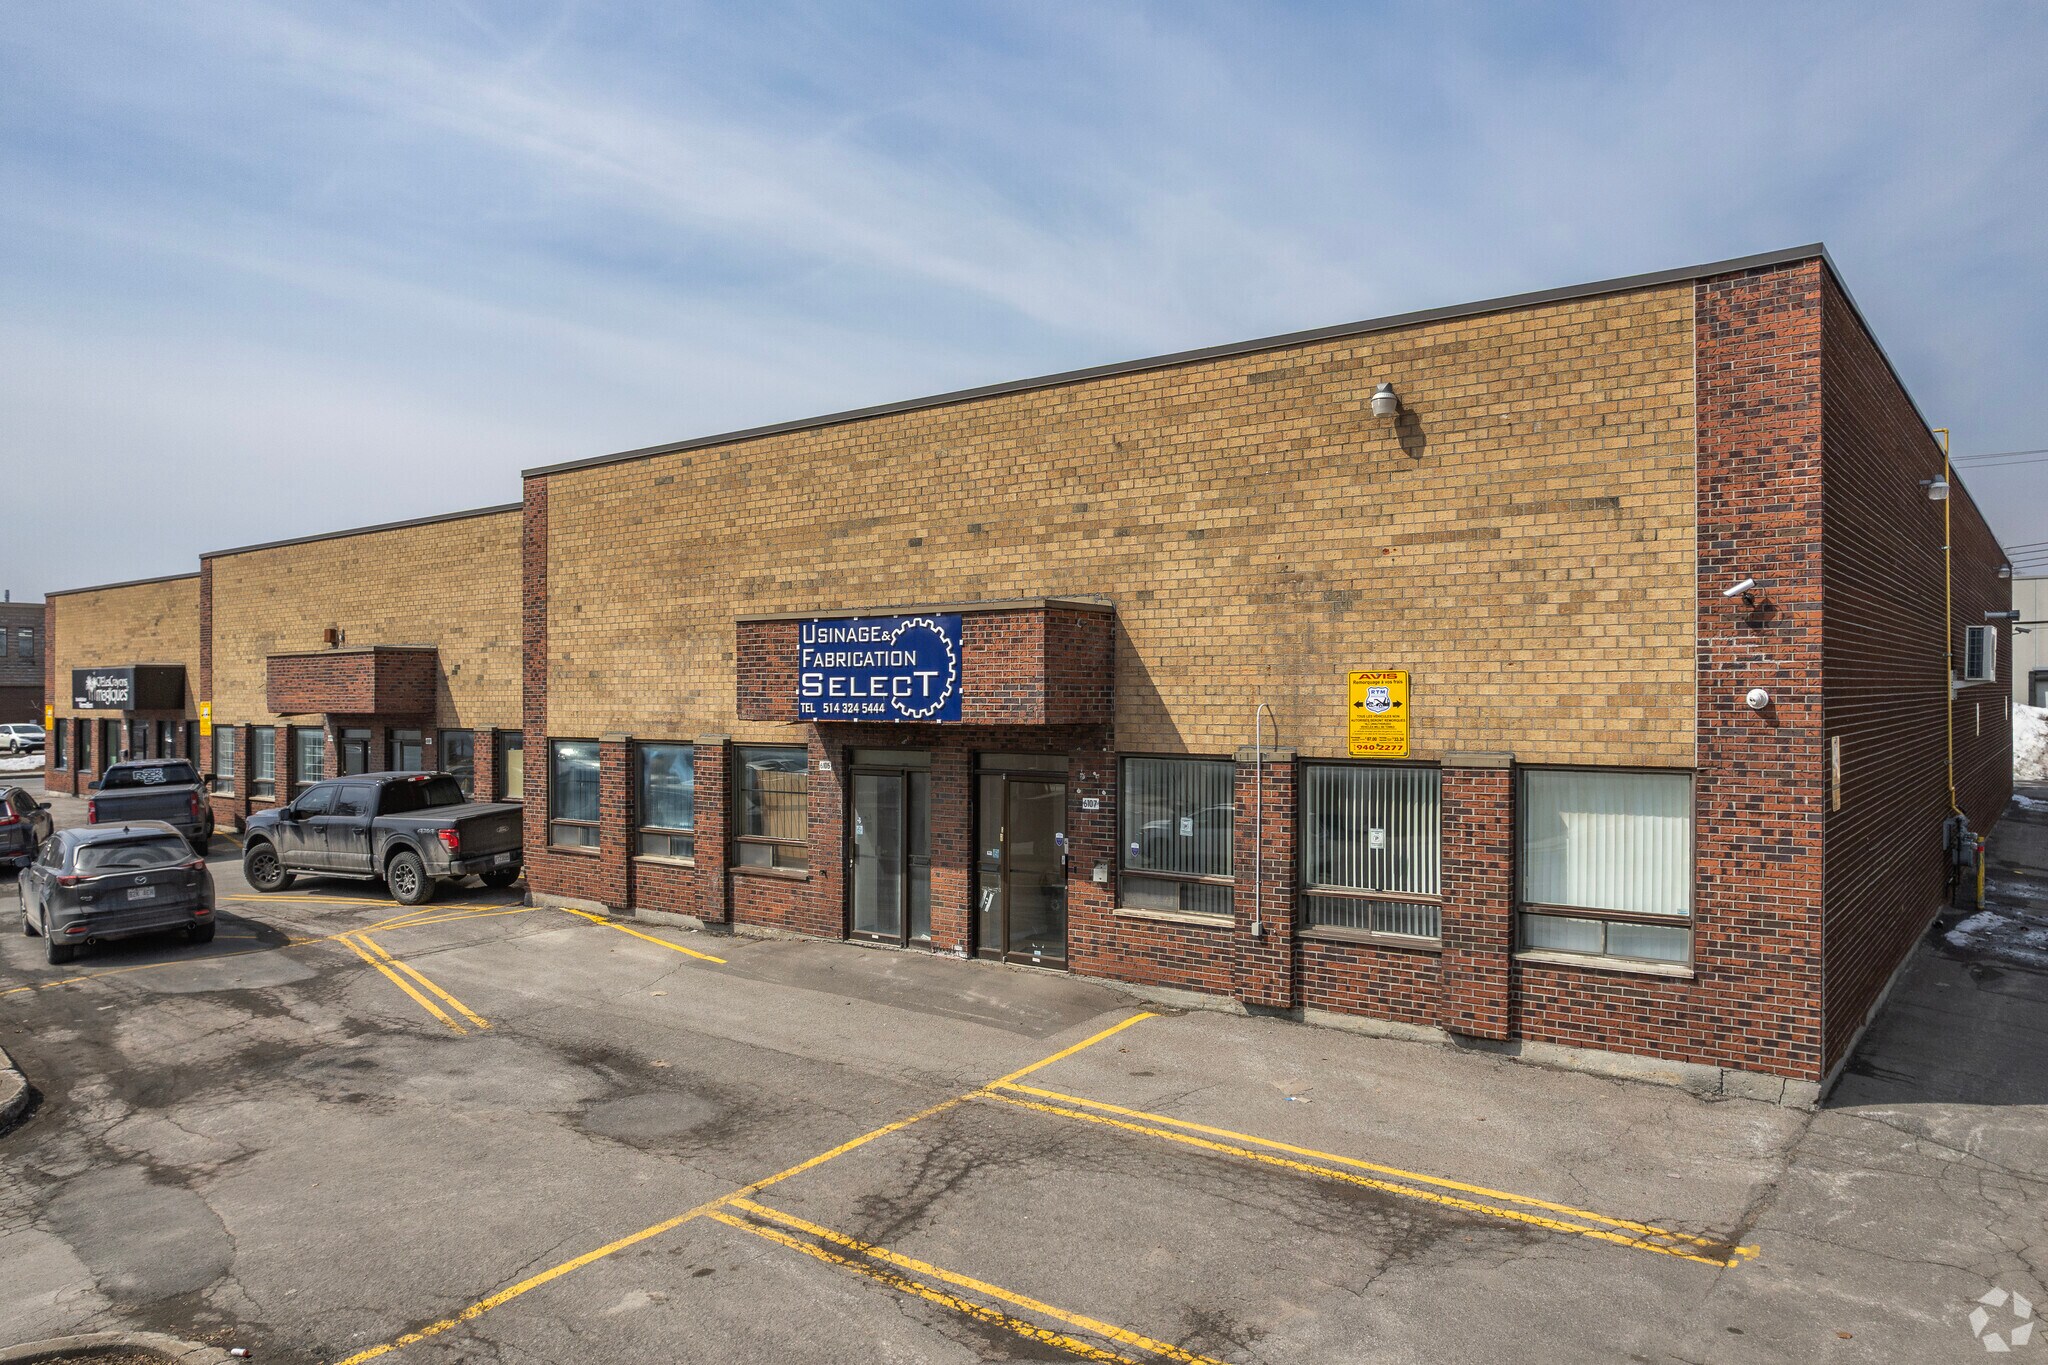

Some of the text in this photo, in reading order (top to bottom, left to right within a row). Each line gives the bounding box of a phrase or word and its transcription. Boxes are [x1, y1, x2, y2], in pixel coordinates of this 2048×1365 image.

[802, 624, 881, 644] USINAGE
[802, 648, 917, 668] FABRICATION
[801, 671, 939, 697] SELECT
[800, 702, 885, 713] TEL 514 324 5444
